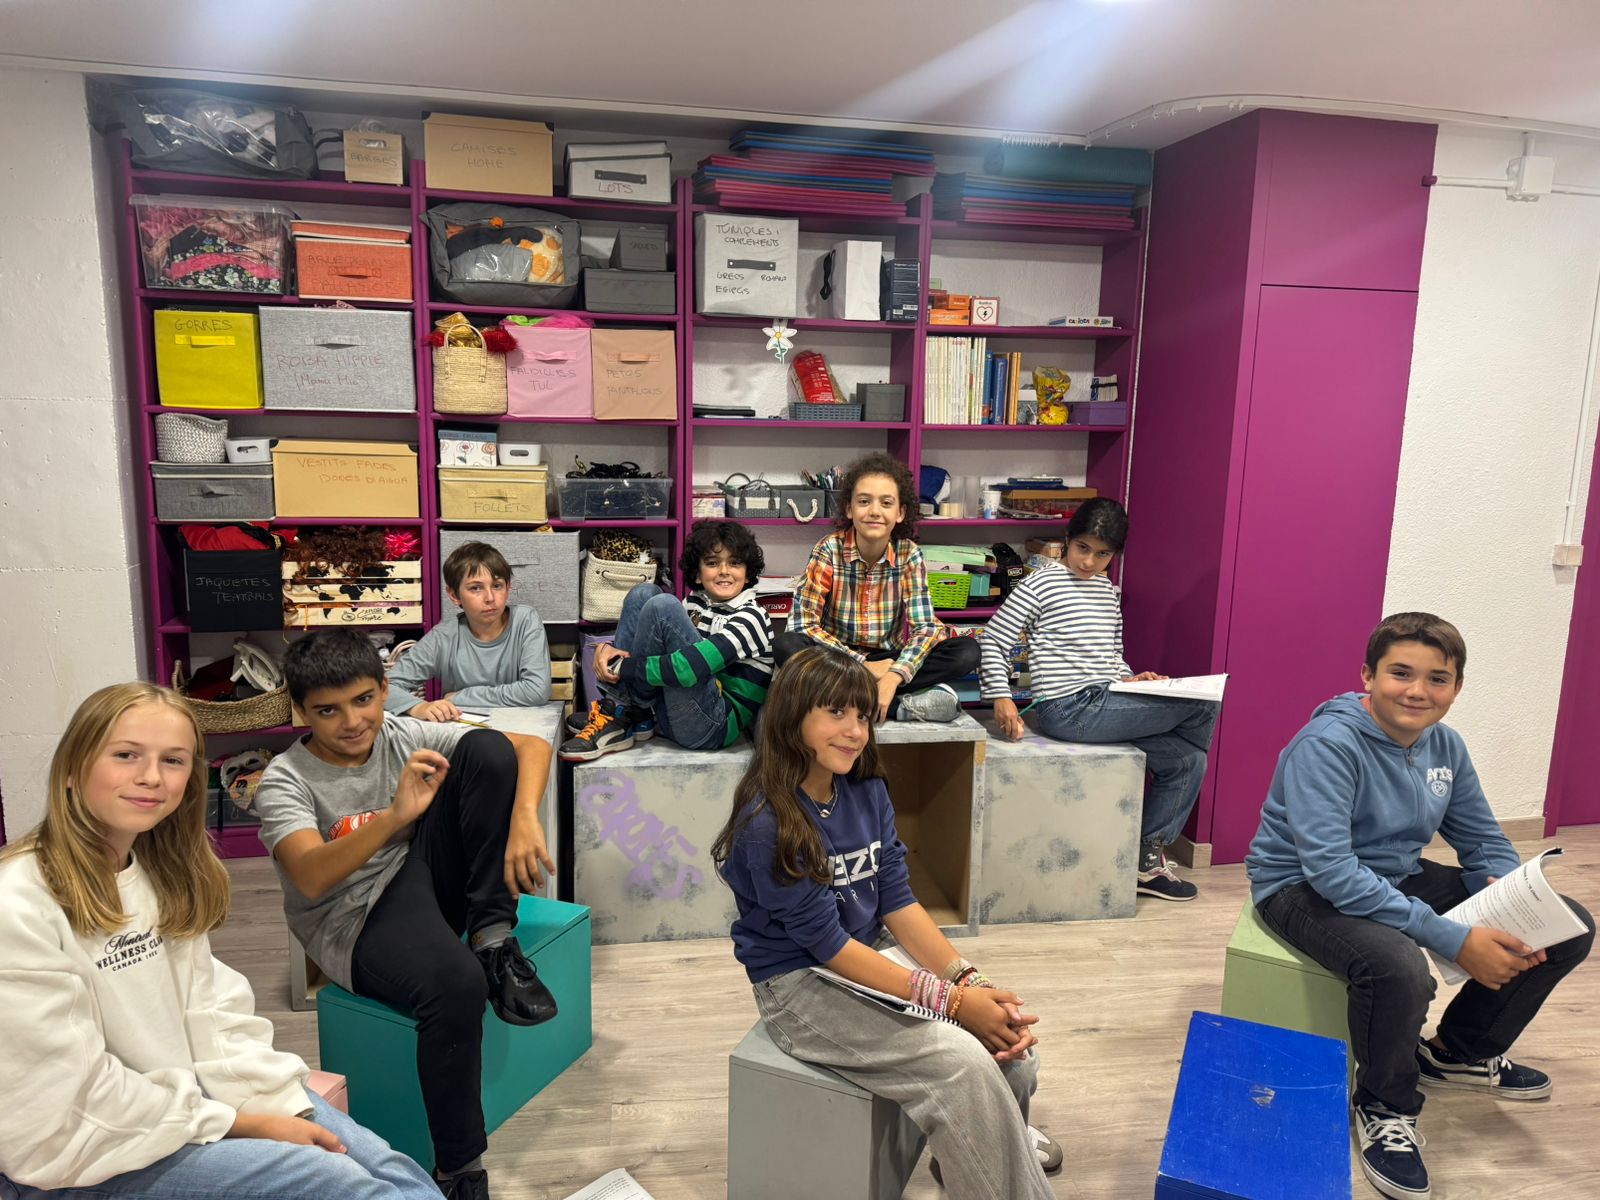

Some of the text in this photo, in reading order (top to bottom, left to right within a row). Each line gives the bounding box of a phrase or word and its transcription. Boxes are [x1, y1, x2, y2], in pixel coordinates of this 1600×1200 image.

[467, 159, 504, 168] HOME
[598, 181, 634, 194] LOTS
[174, 319, 233, 332] GORRES
[276, 353, 384, 369] ROBA HIPPIE
[528, 380, 553, 391] TUL
[473, 501, 530, 513] FOLLETS
[195, 576, 272, 589] JAQUETES
[211, 591, 275, 605] TEATRALS
[95, 943, 147, 970] WELLNESS
[112, 956, 143, 972] CANADA
